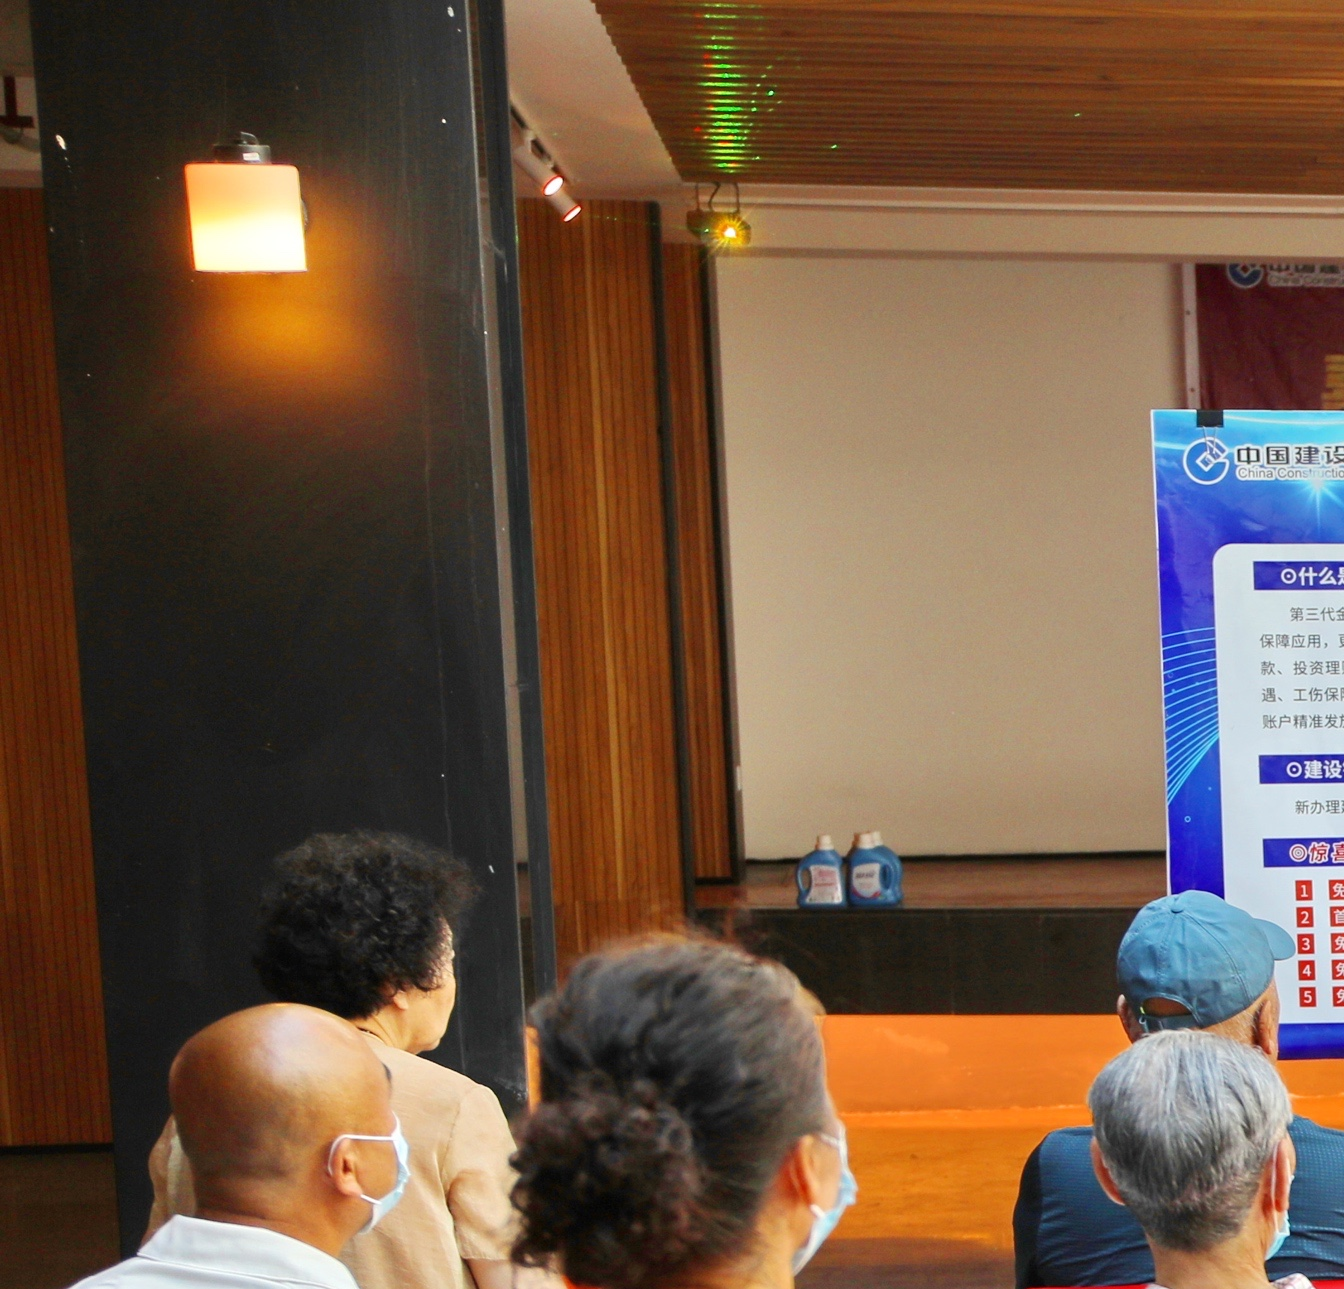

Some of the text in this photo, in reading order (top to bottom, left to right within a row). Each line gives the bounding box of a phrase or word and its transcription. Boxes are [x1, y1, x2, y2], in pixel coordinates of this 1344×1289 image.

[1238, 467, 1274, 479] China
[1301, 884, 1309, 898] 1
[1301, 911, 1310, 924] 2
[1302, 937, 1311, 951] 3
[1302, 963, 1311, 977] 4
[1303, 990, 1312, 1004] 5
